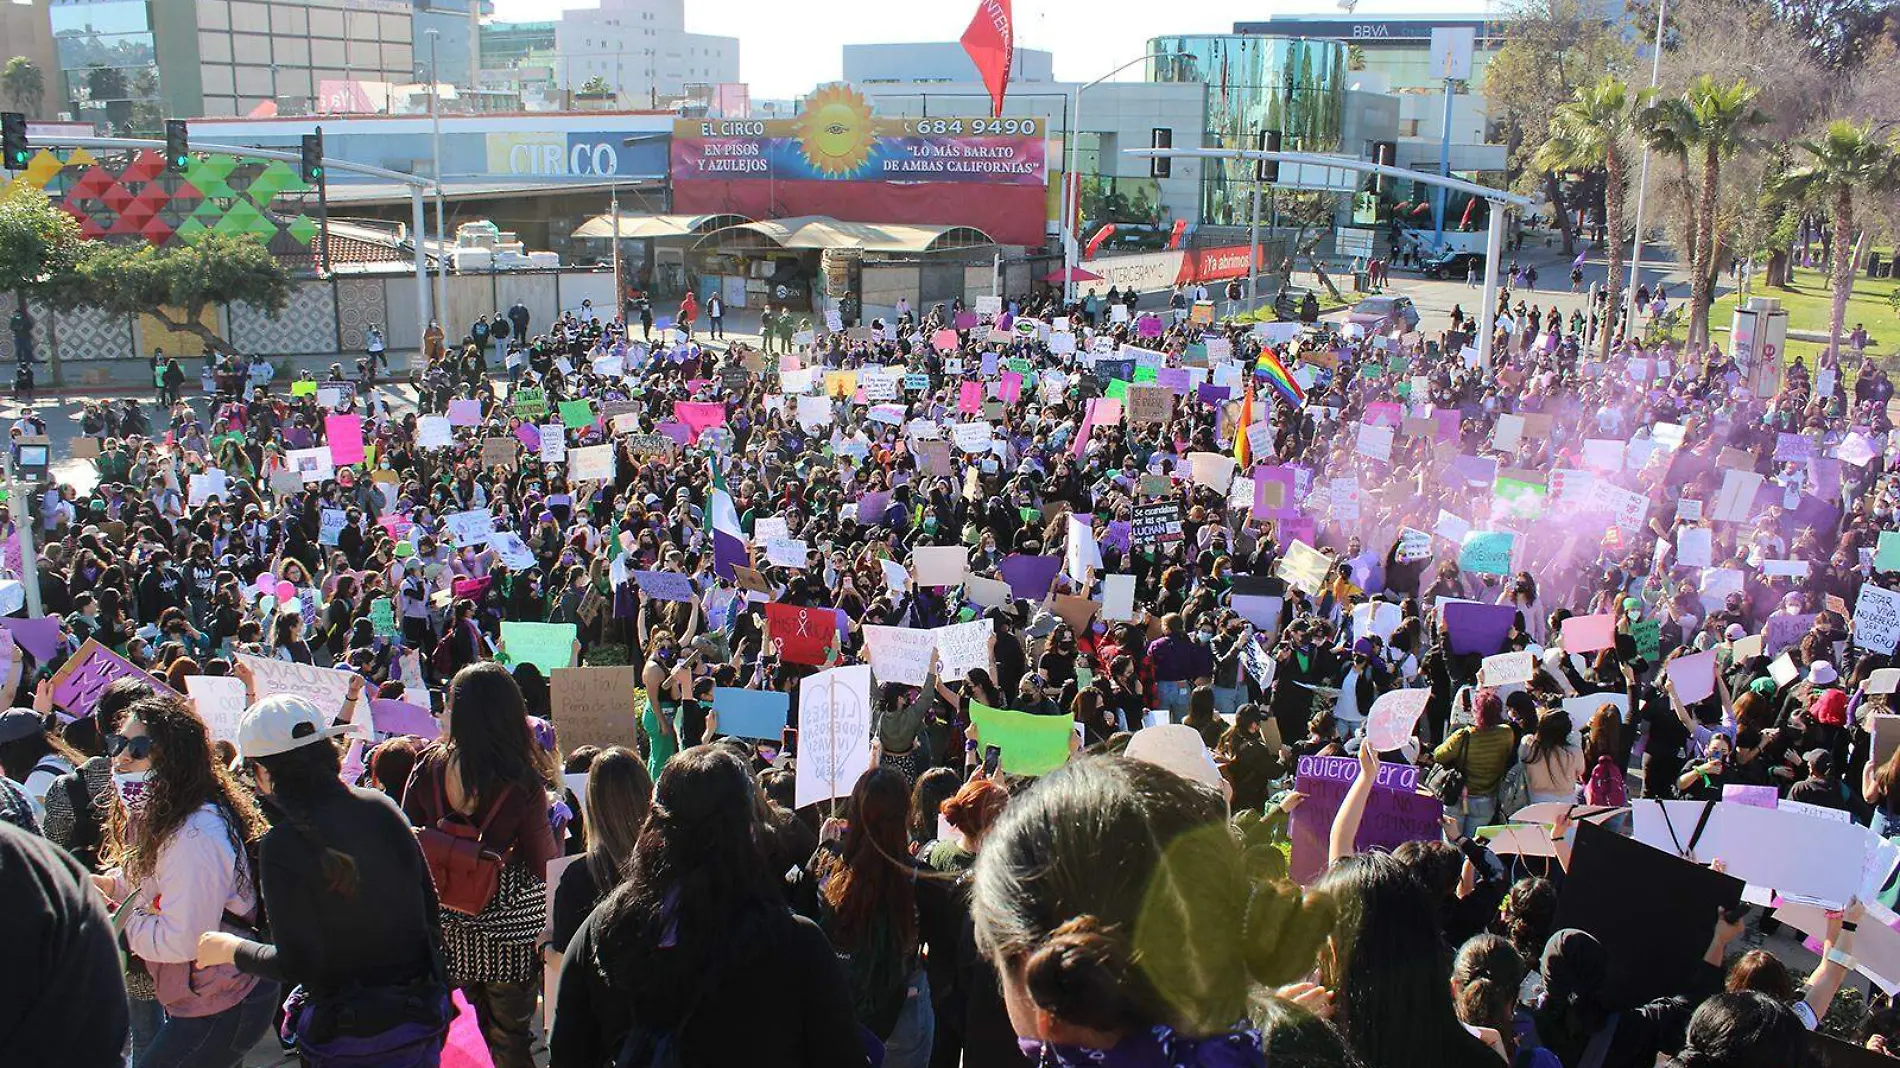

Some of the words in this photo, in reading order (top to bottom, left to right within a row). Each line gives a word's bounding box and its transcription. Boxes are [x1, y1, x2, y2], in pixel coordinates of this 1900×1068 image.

[1353, 24, 1388, 37] BBVA
[701, 122, 717, 136] EL
[721, 122, 765, 136] CIRCO
[917, 119, 963, 135] 684
[971, 119, 1036, 135] 9490
[704, 144, 721, 156] EN
[724, 144, 759, 156] PISOS
[935, 143, 960, 158] MÁS
[964, 146, 1014, 159] BARATO
[510, 143, 618, 176] CIRCO
[697, 159, 706, 171] Y
[709, 159, 768, 173] AZULEJOS
[883, 160, 901, 172] DE
[902, 160, 944, 173] AMBAS
[1204, 256, 1217, 275] ¡Ya
[1862, 590, 1893, 608] ESTAR
[1857, 610, 1869, 620] NO
[1876, 605, 1896, 619] VIVA
[1864, 621, 1877, 630] SER
[1857, 629, 1895, 649] LOGRO
[560, 671, 586, 699] Soy
[1376, 765, 1398, 786] er
[1400, 768, 1415, 788] a
